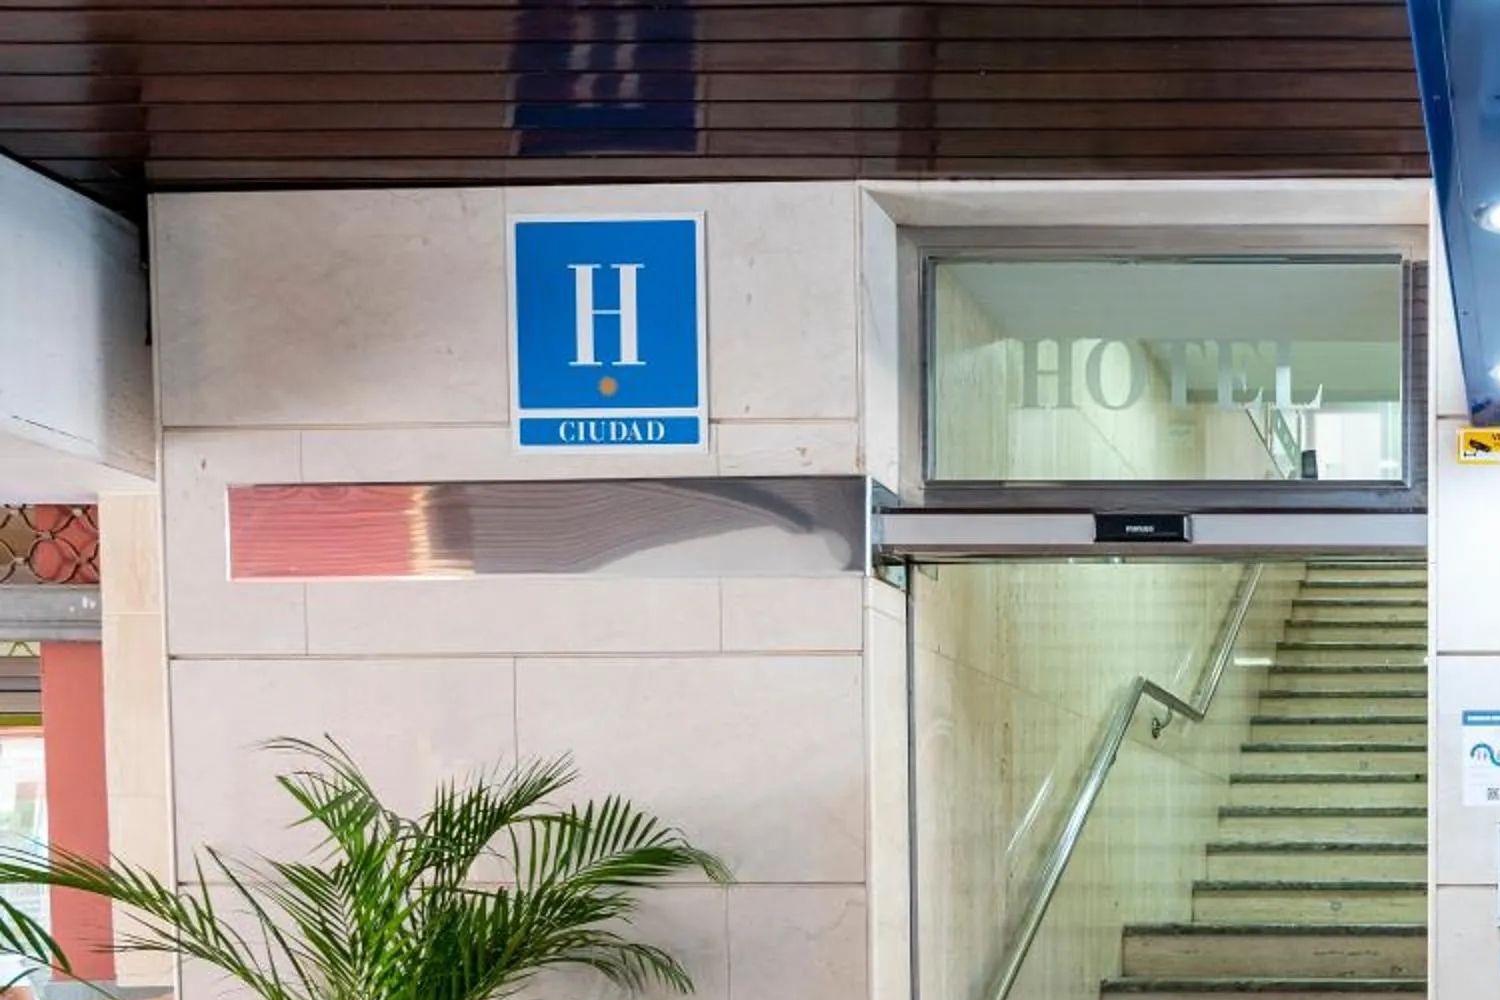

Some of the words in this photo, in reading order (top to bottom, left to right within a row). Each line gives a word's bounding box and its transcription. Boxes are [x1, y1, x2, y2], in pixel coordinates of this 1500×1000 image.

[567, 263, 647, 367] H
[1011, 337, 1323, 412] HOTEL
[559, 420, 666, 442] CIUDAD
